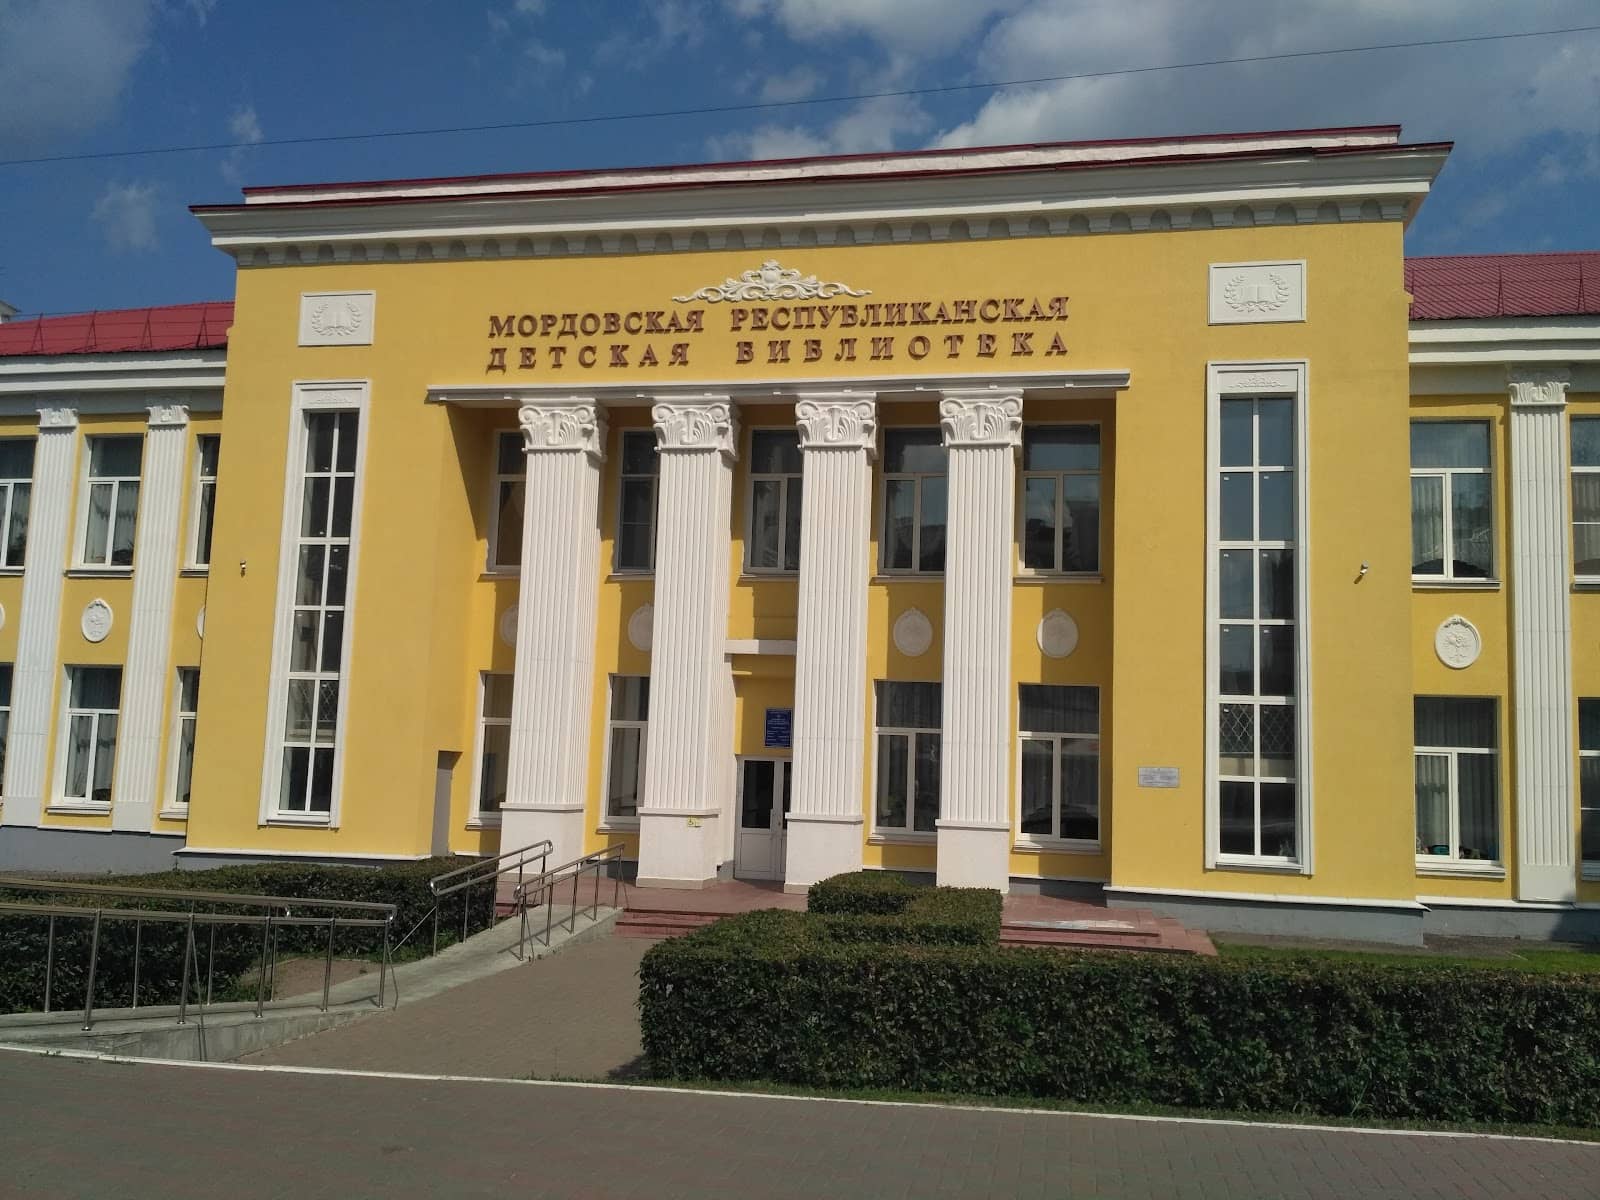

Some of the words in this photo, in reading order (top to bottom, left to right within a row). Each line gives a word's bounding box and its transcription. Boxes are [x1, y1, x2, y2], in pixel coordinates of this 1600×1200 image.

[488, 310, 705, 341] МОРДОВСКАЯ
[730, 297, 1069, 332] РЕСПУБЛИКАНСКАЯ
[485, 343, 690, 375] ДЕТСКАЯ
[735, 331, 1068, 364] БИБЛИОТЕКА
